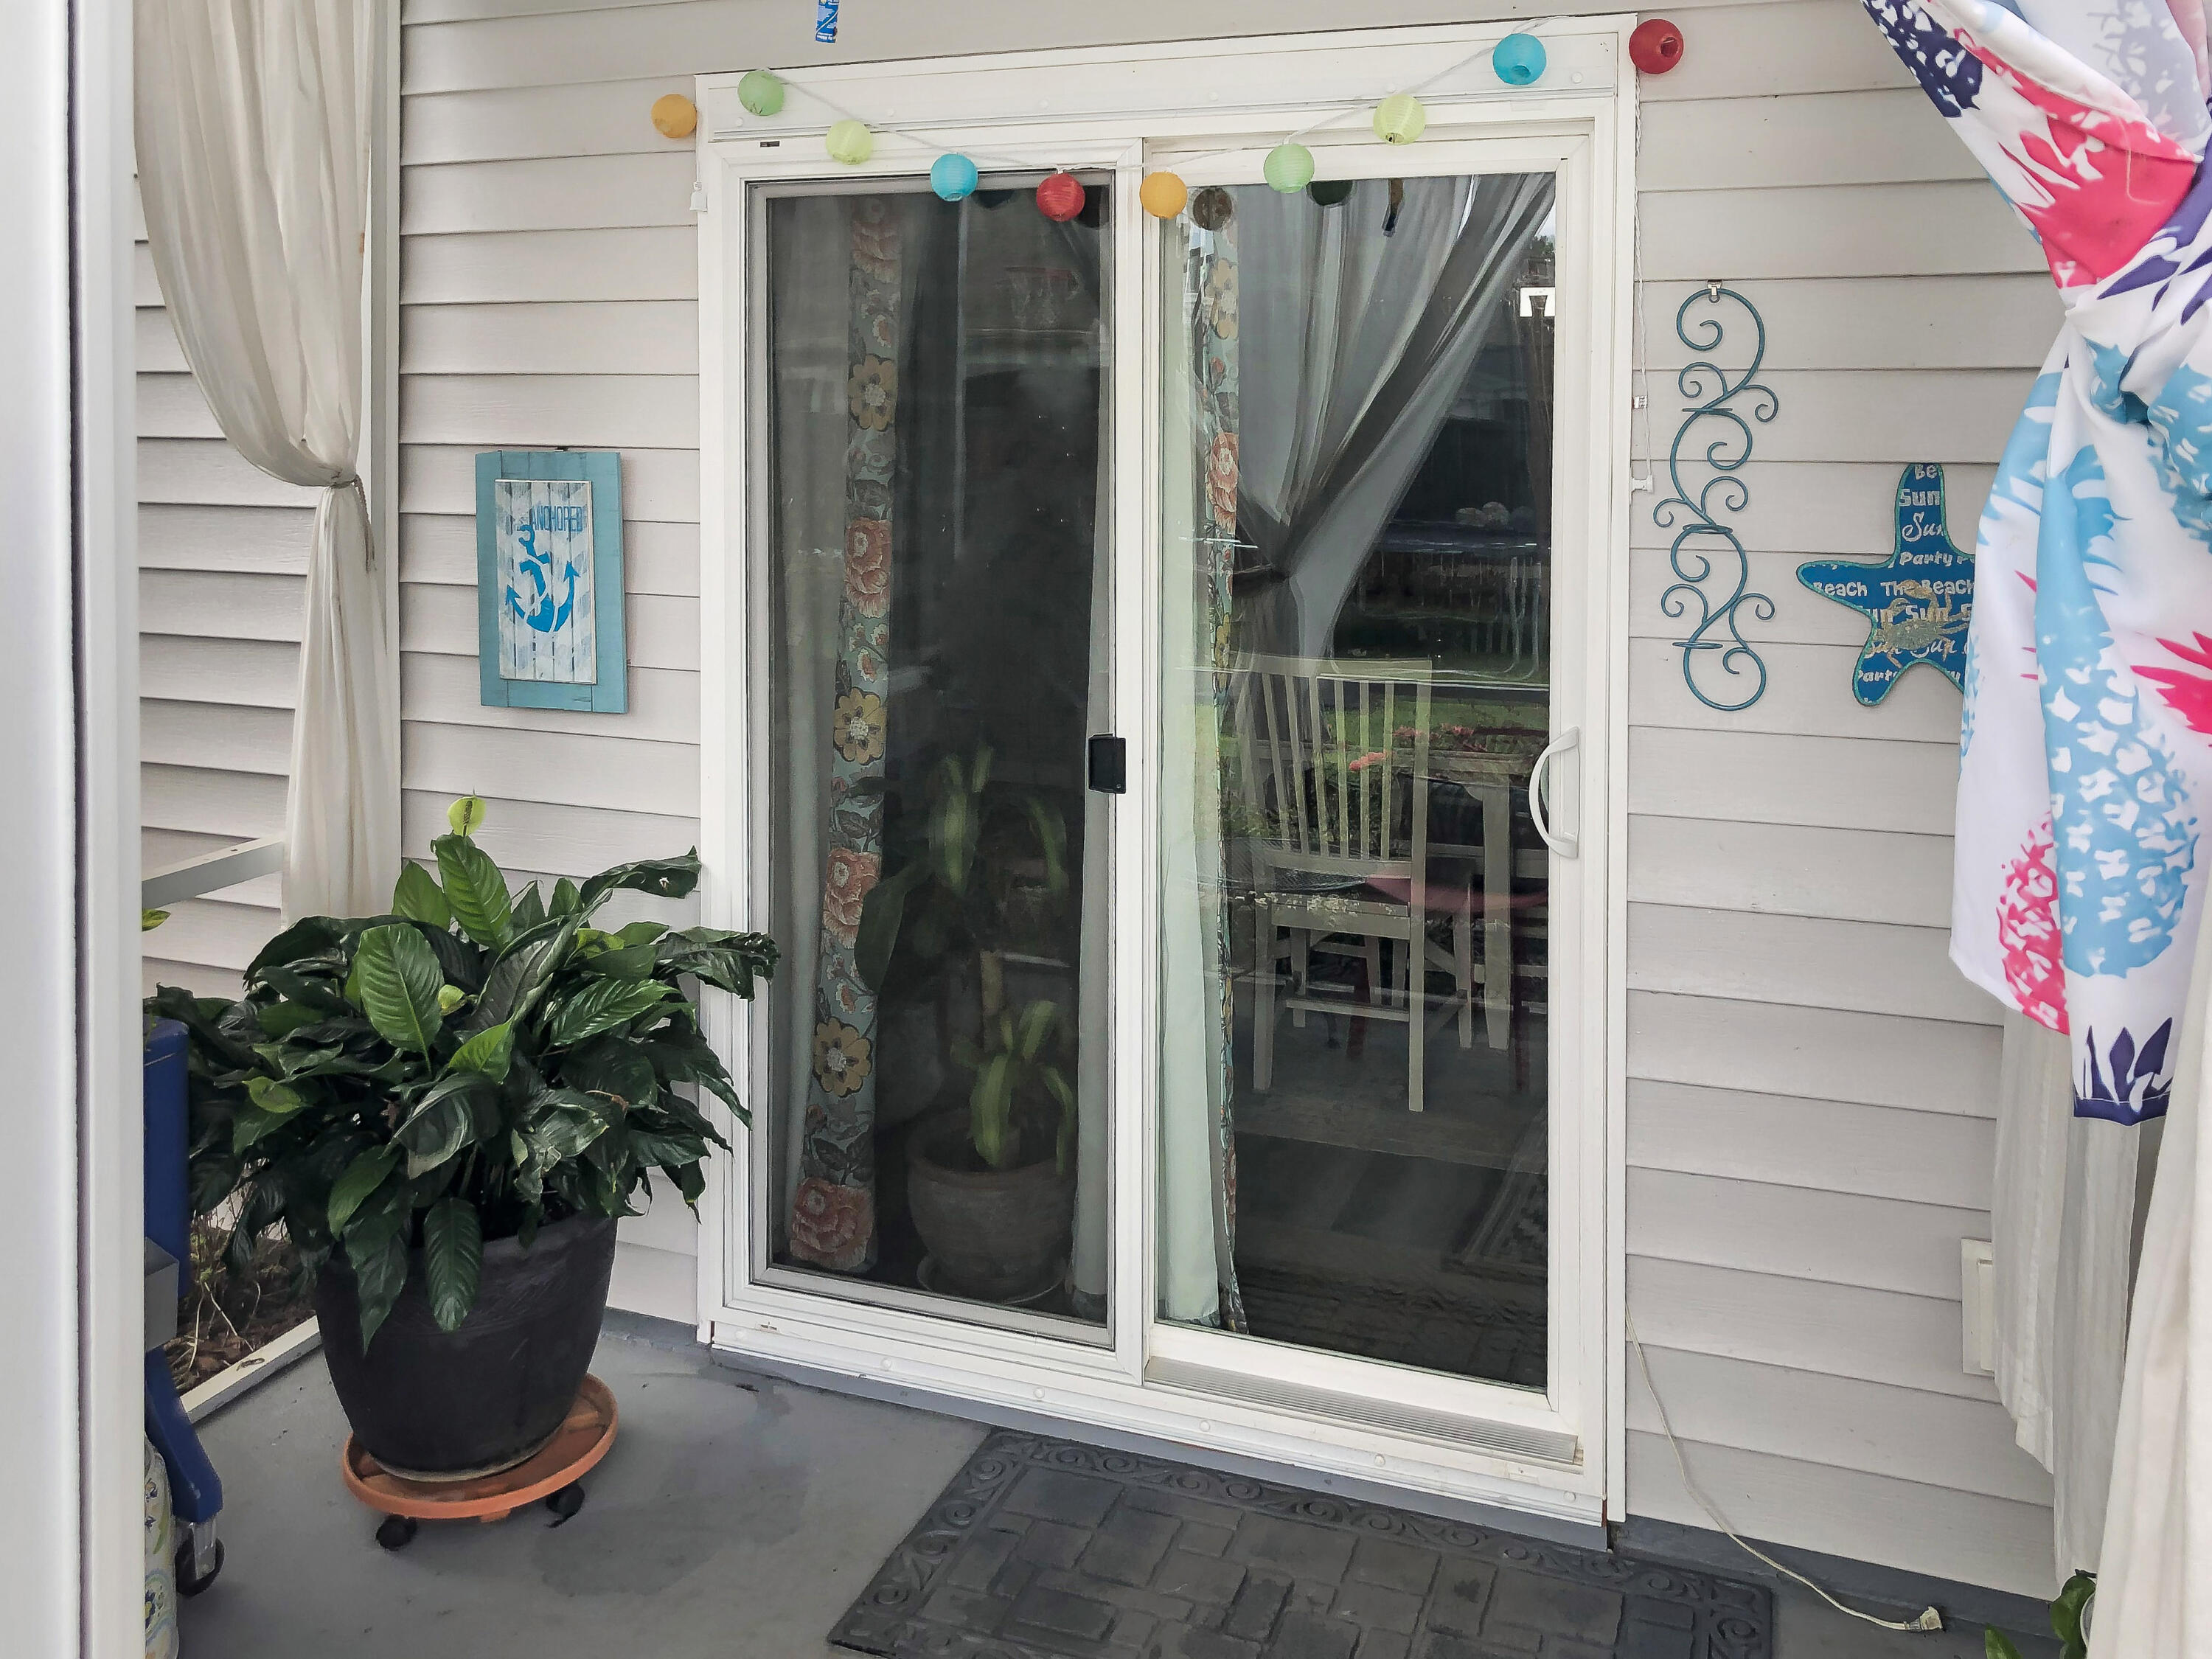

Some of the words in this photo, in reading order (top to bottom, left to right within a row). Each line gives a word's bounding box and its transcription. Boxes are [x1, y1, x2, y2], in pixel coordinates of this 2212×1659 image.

[1899, 488, 1941, 507] Sun
[531, 506, 583, 532] ANCHORED
[1899, 551, 1953, 567] Party
[1880, 581, 1910, 597] Th
